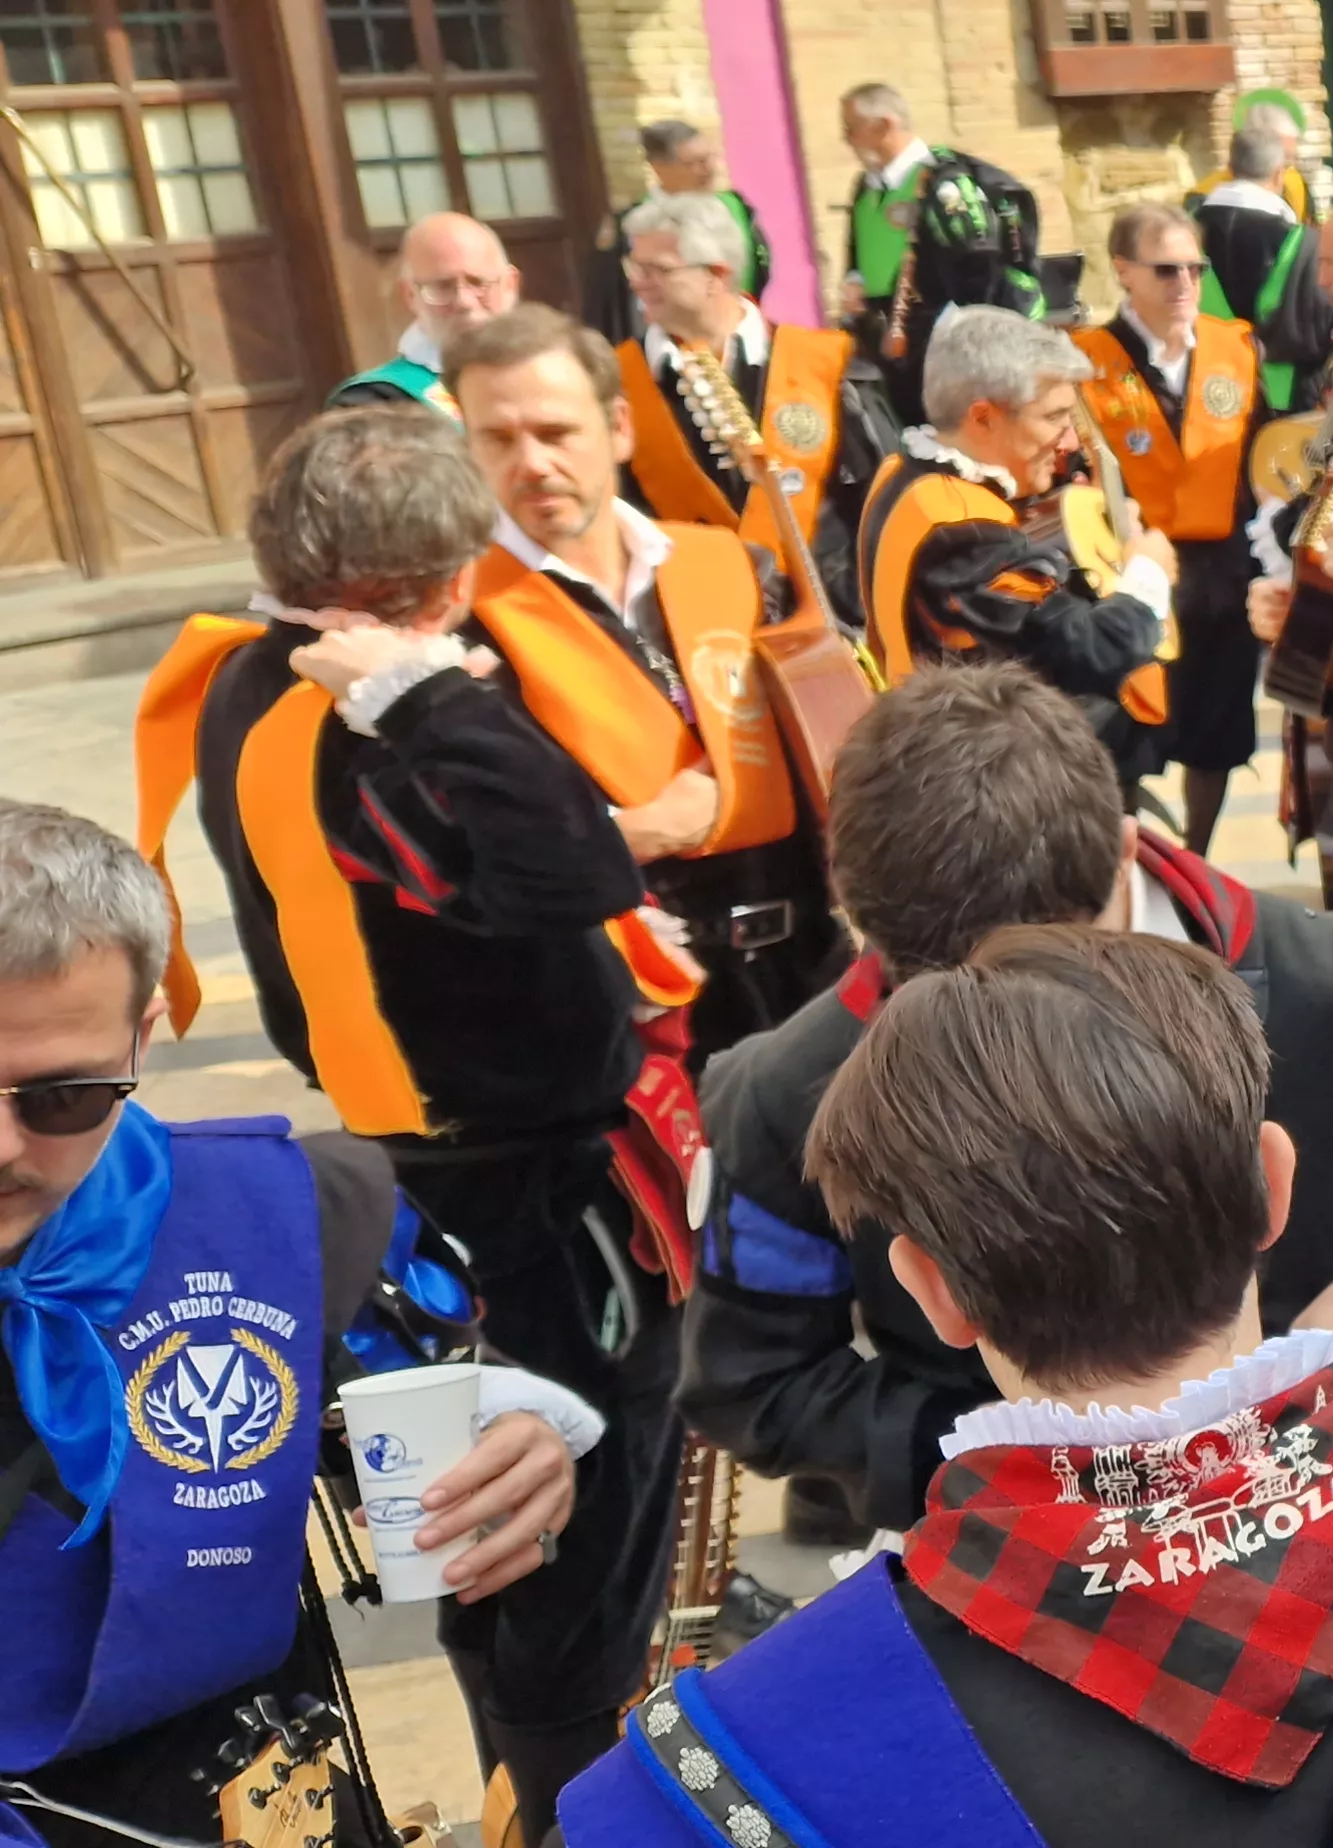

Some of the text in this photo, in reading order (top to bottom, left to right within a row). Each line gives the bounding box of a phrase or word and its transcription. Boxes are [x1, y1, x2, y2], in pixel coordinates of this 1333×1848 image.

[184, 1271, 234, 1295] TUNA
[118, 1295, 299, 1350] C.M.U. PEDRO CERBUNA
[173, 1478, 267, 1509] ZARAGOZA
[187, 1546, 252, 1567] DONOSO
